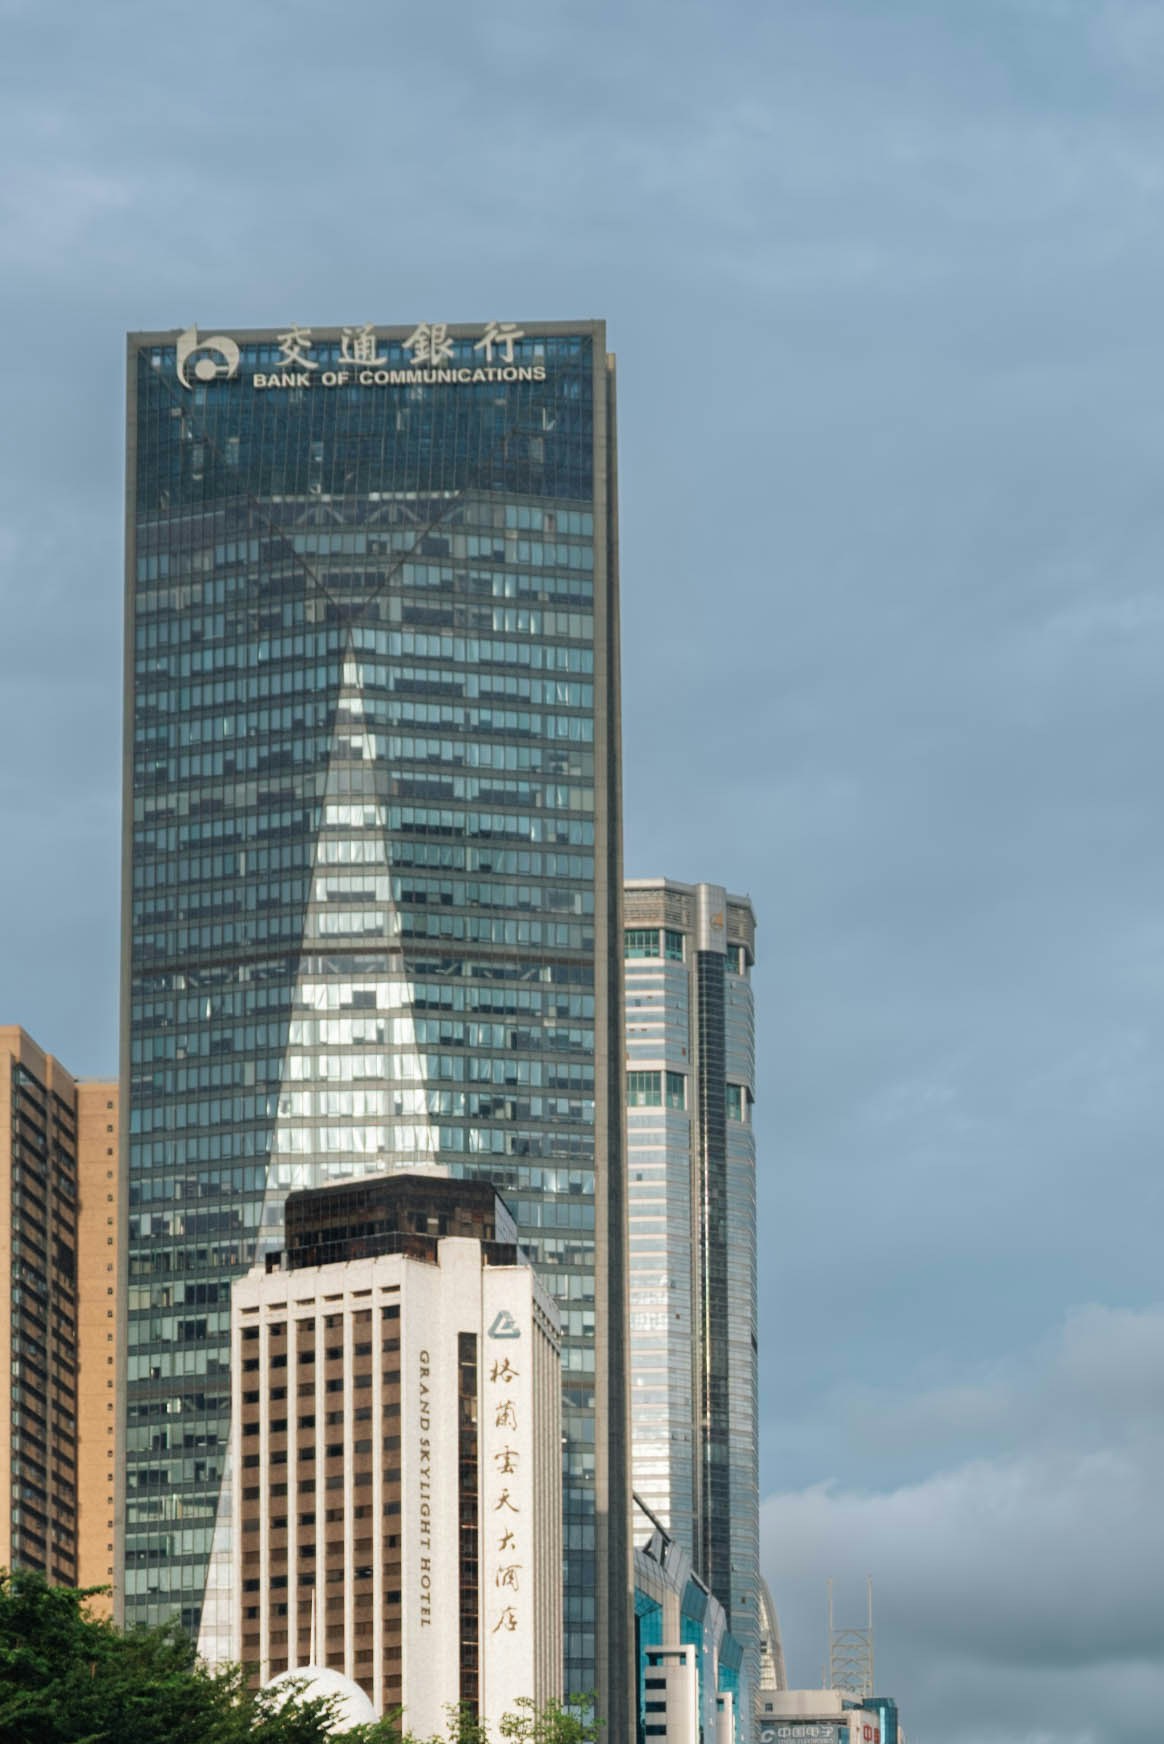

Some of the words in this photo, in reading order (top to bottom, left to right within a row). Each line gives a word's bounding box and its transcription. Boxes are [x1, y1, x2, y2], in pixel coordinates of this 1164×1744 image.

[253, 371, 310, 388] BANK
[322, 371, 349, 386] OF
[359, 366, 546, 385] COMMUNICATIONS
[275, 320, 525, 369] 交通銀行
[419, 1349, 431, 1432] GRAND
[419, 1438, 431, 1554] SKYLIGHT
[420, 1558, 432, 1628] HOTEL
